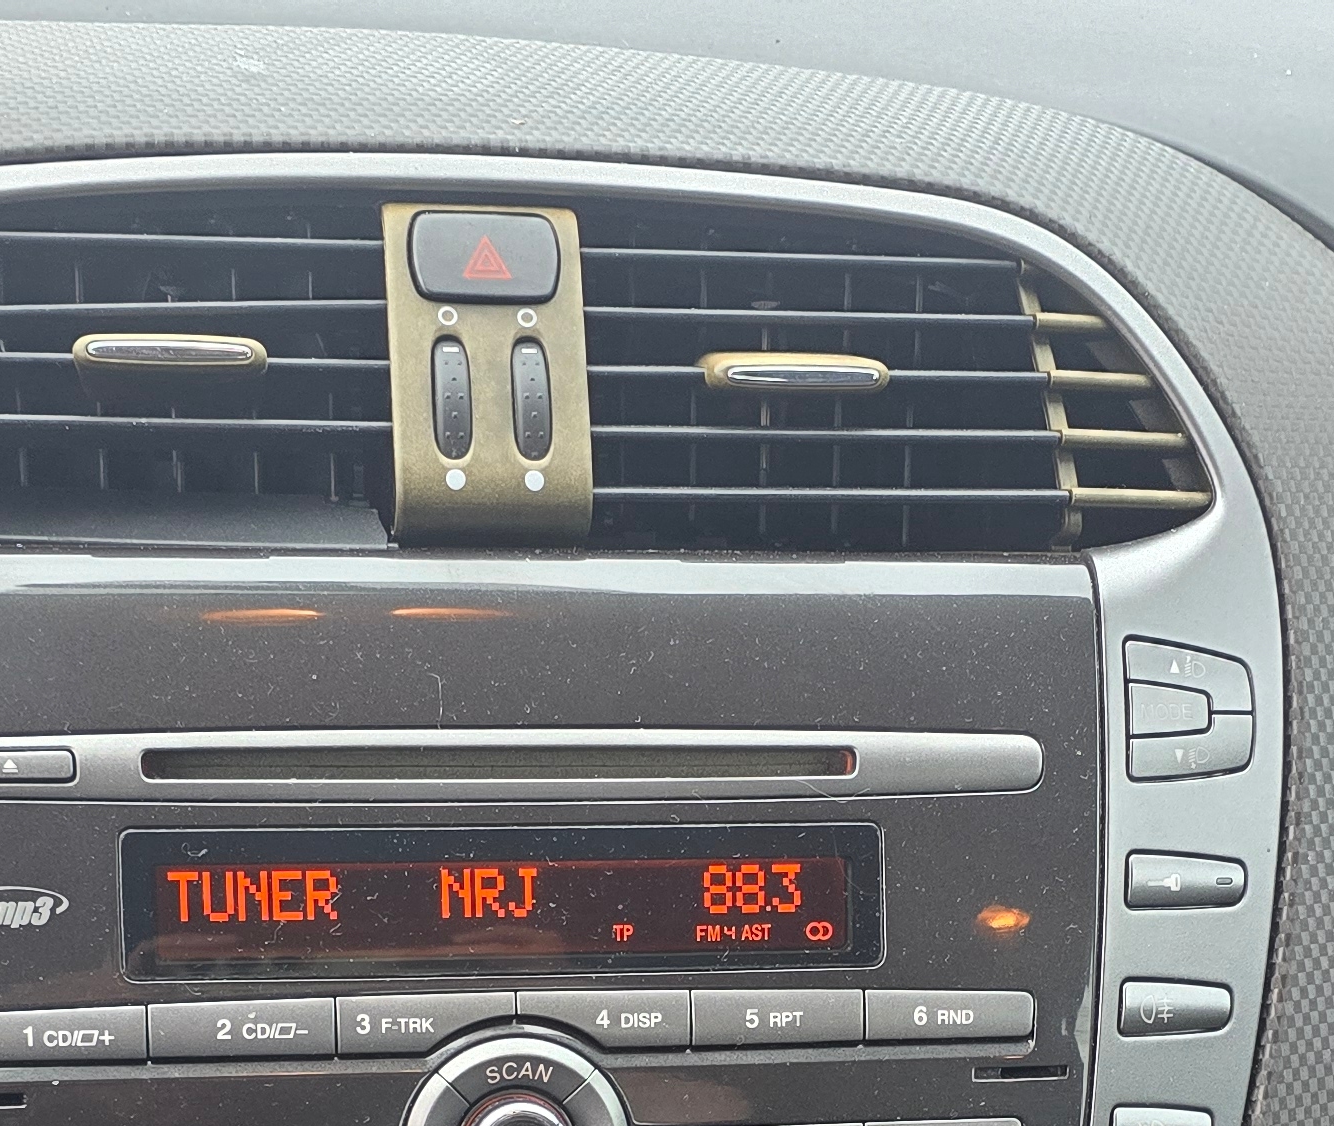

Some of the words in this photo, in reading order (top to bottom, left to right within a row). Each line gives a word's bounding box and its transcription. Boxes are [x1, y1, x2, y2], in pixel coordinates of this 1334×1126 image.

[1140, 703, 1193, 720] MODE
[167, 869, 337, 922] TUNER
[440, 866, 537, 918] NRJ
[703, 862, 801, 914] 88.3
[613, 923, 634, 941] TP
[355, 1013, 371, 1035] 3
[381, 1017, 435, 1034] F-TRK
[595, 1009, 611, 1029] 4
[620, 1012, 662, 1028] DISP
[745, 1008, 760, 1029] 5
[769, 1011, 804, 1028] RPT
[913, 1005, 928, 1026] 6
[937, 1009, 975, 1025] RND
[22, 1025, 34, 1047] 1
[216, 1018, 232, 1040] 2
[485, 1061, 554, 1084] SCAN
